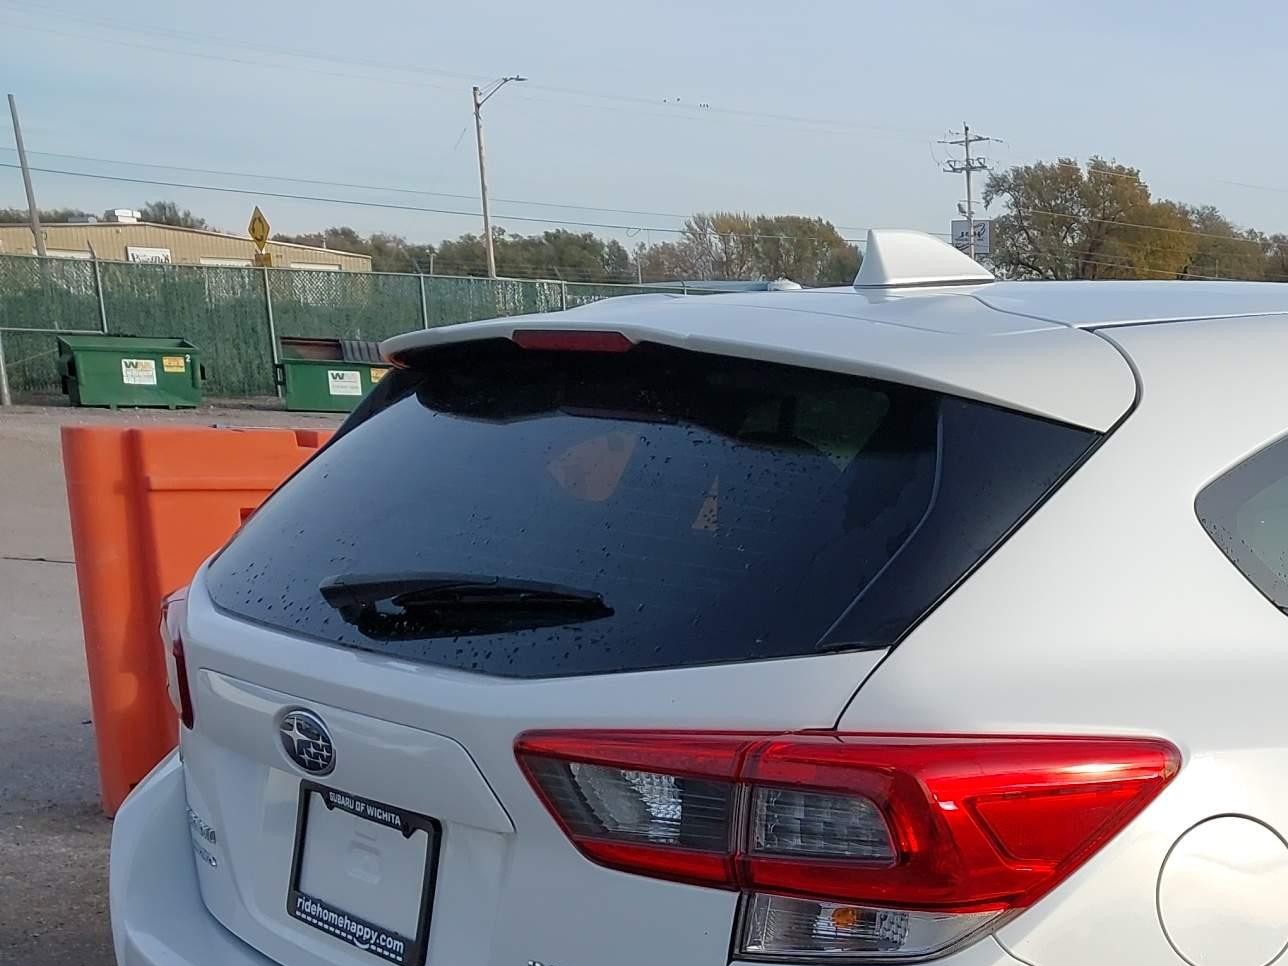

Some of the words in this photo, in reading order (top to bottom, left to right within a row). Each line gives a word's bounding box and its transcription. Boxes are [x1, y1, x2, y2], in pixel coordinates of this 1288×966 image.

[185, 354, 191, 362] 2
[329, 792, 355, 809] SUBARU
[355, 801, 366, 812] OF
[366, 805, 401, 825] WICHITA
[297, 897, 404, 954] ridehomehappy.com
